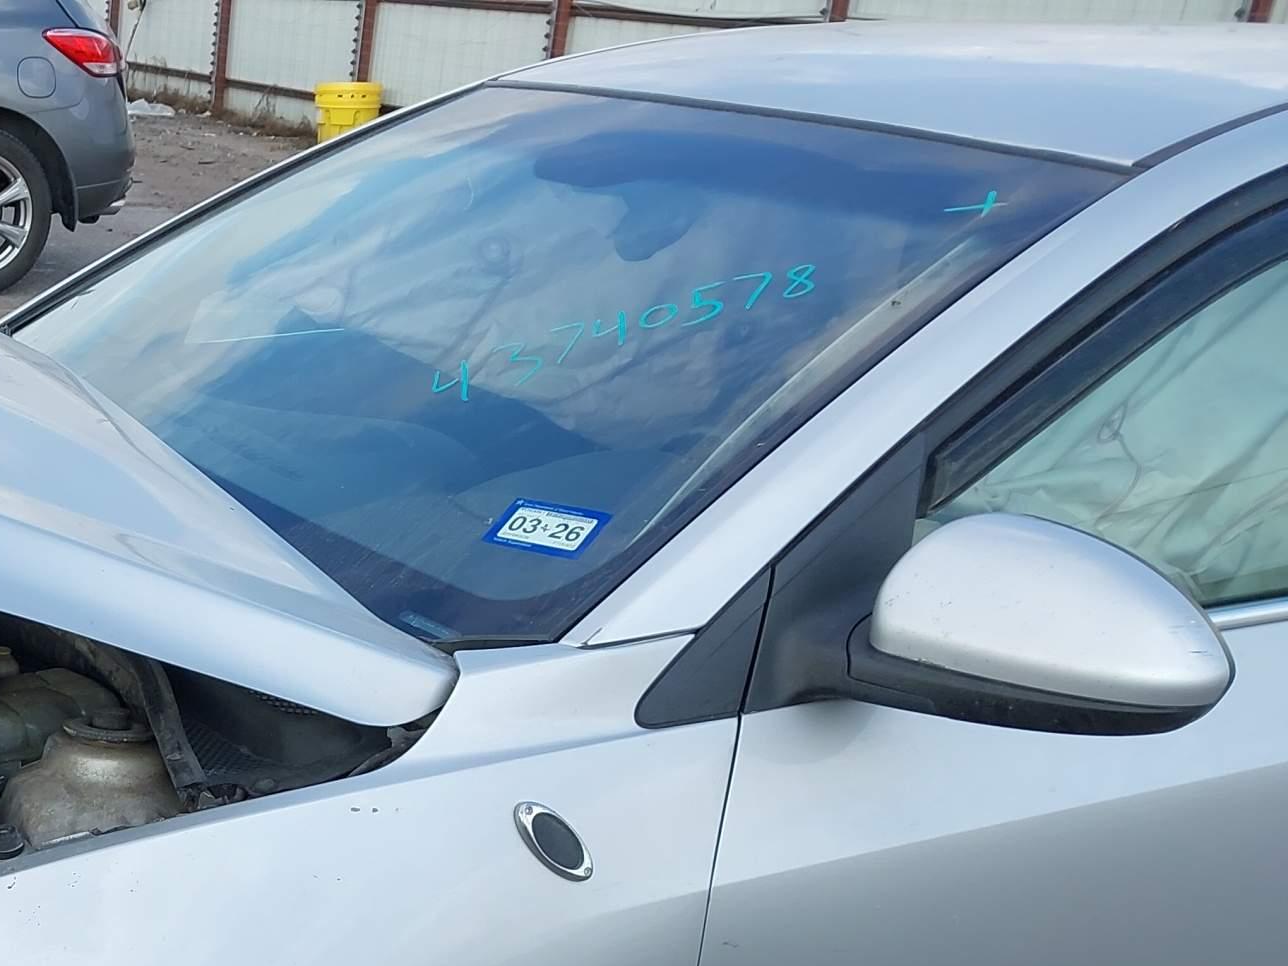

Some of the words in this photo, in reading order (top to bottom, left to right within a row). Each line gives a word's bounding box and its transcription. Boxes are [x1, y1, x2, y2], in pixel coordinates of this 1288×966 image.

[431, 264, 816, 402] 43740578
[508, 515, 542, 534] 03
[547, 523, 585, 542] 26
